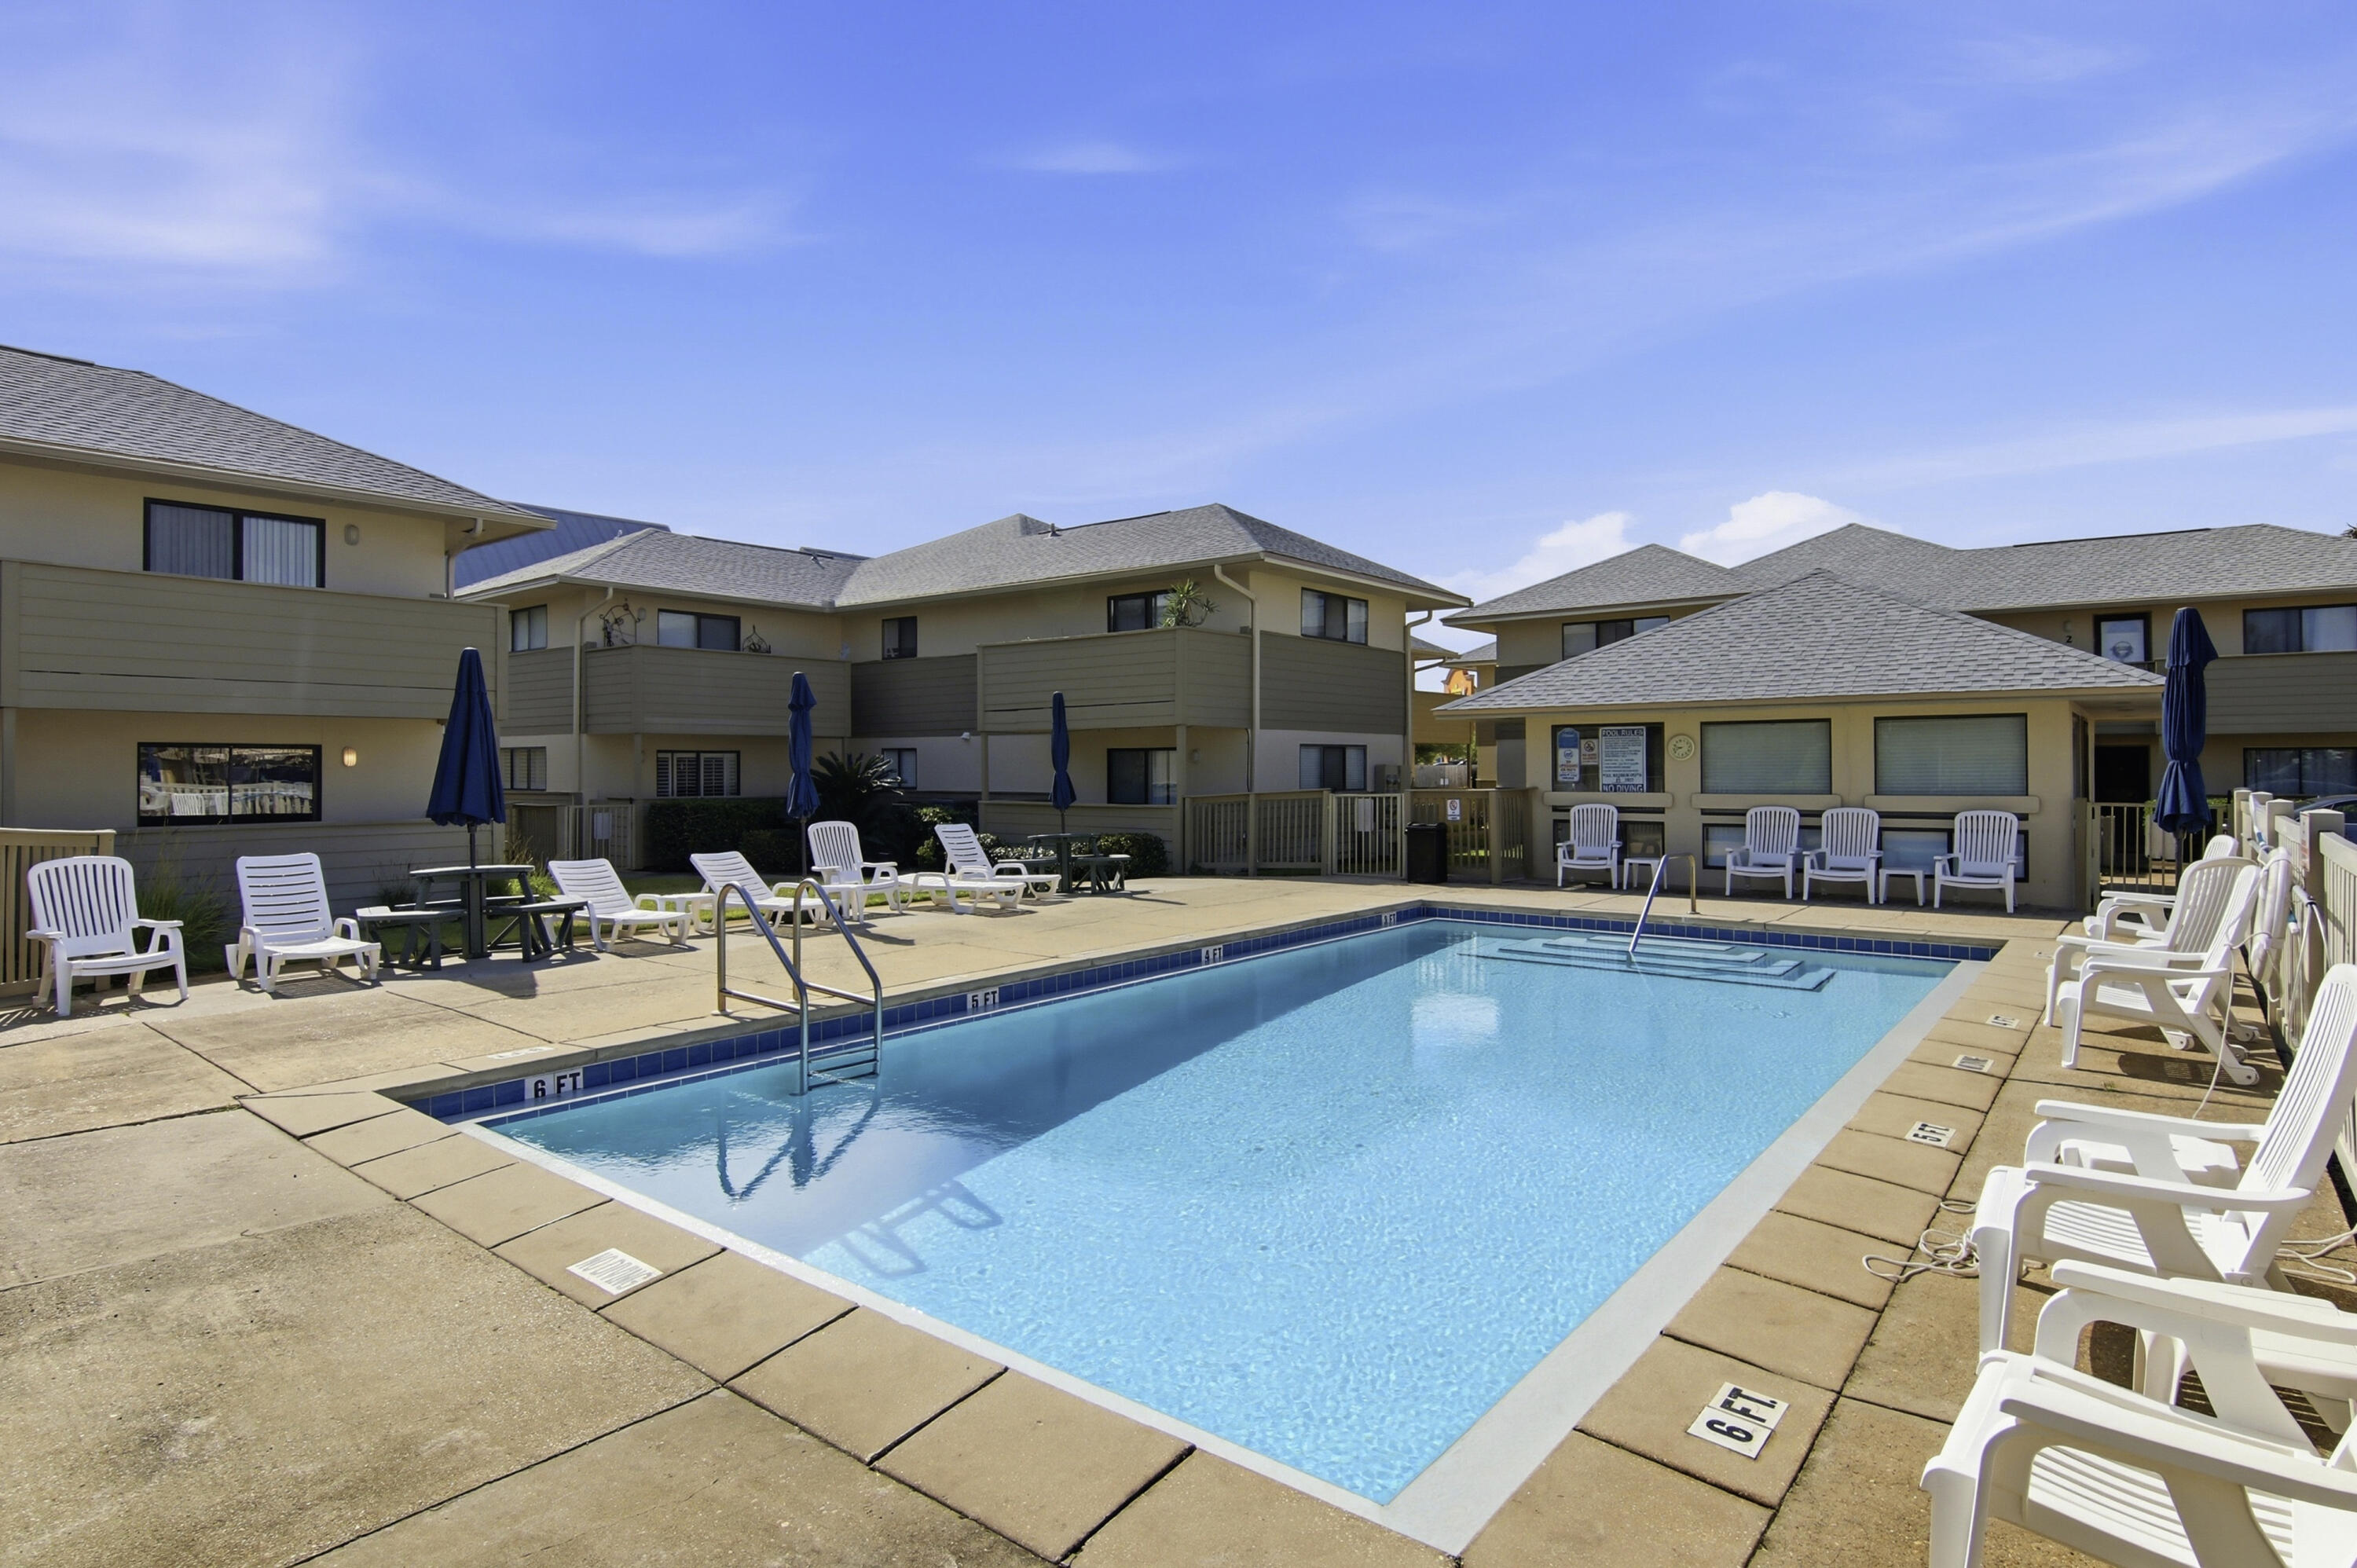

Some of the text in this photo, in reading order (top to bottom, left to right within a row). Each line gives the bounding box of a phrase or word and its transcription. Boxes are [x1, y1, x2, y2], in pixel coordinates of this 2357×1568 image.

[2066, 635, 2073, 643] 2
[1204, 947, 1222, 959] 4 FT
[971, 991, 997, 1008] 5 FT
[533, 1072, 581, 1098] 6 FT
[1912, 1133, 1942, 1142] 5
[1706, 1419, 1754, 1442] 6
